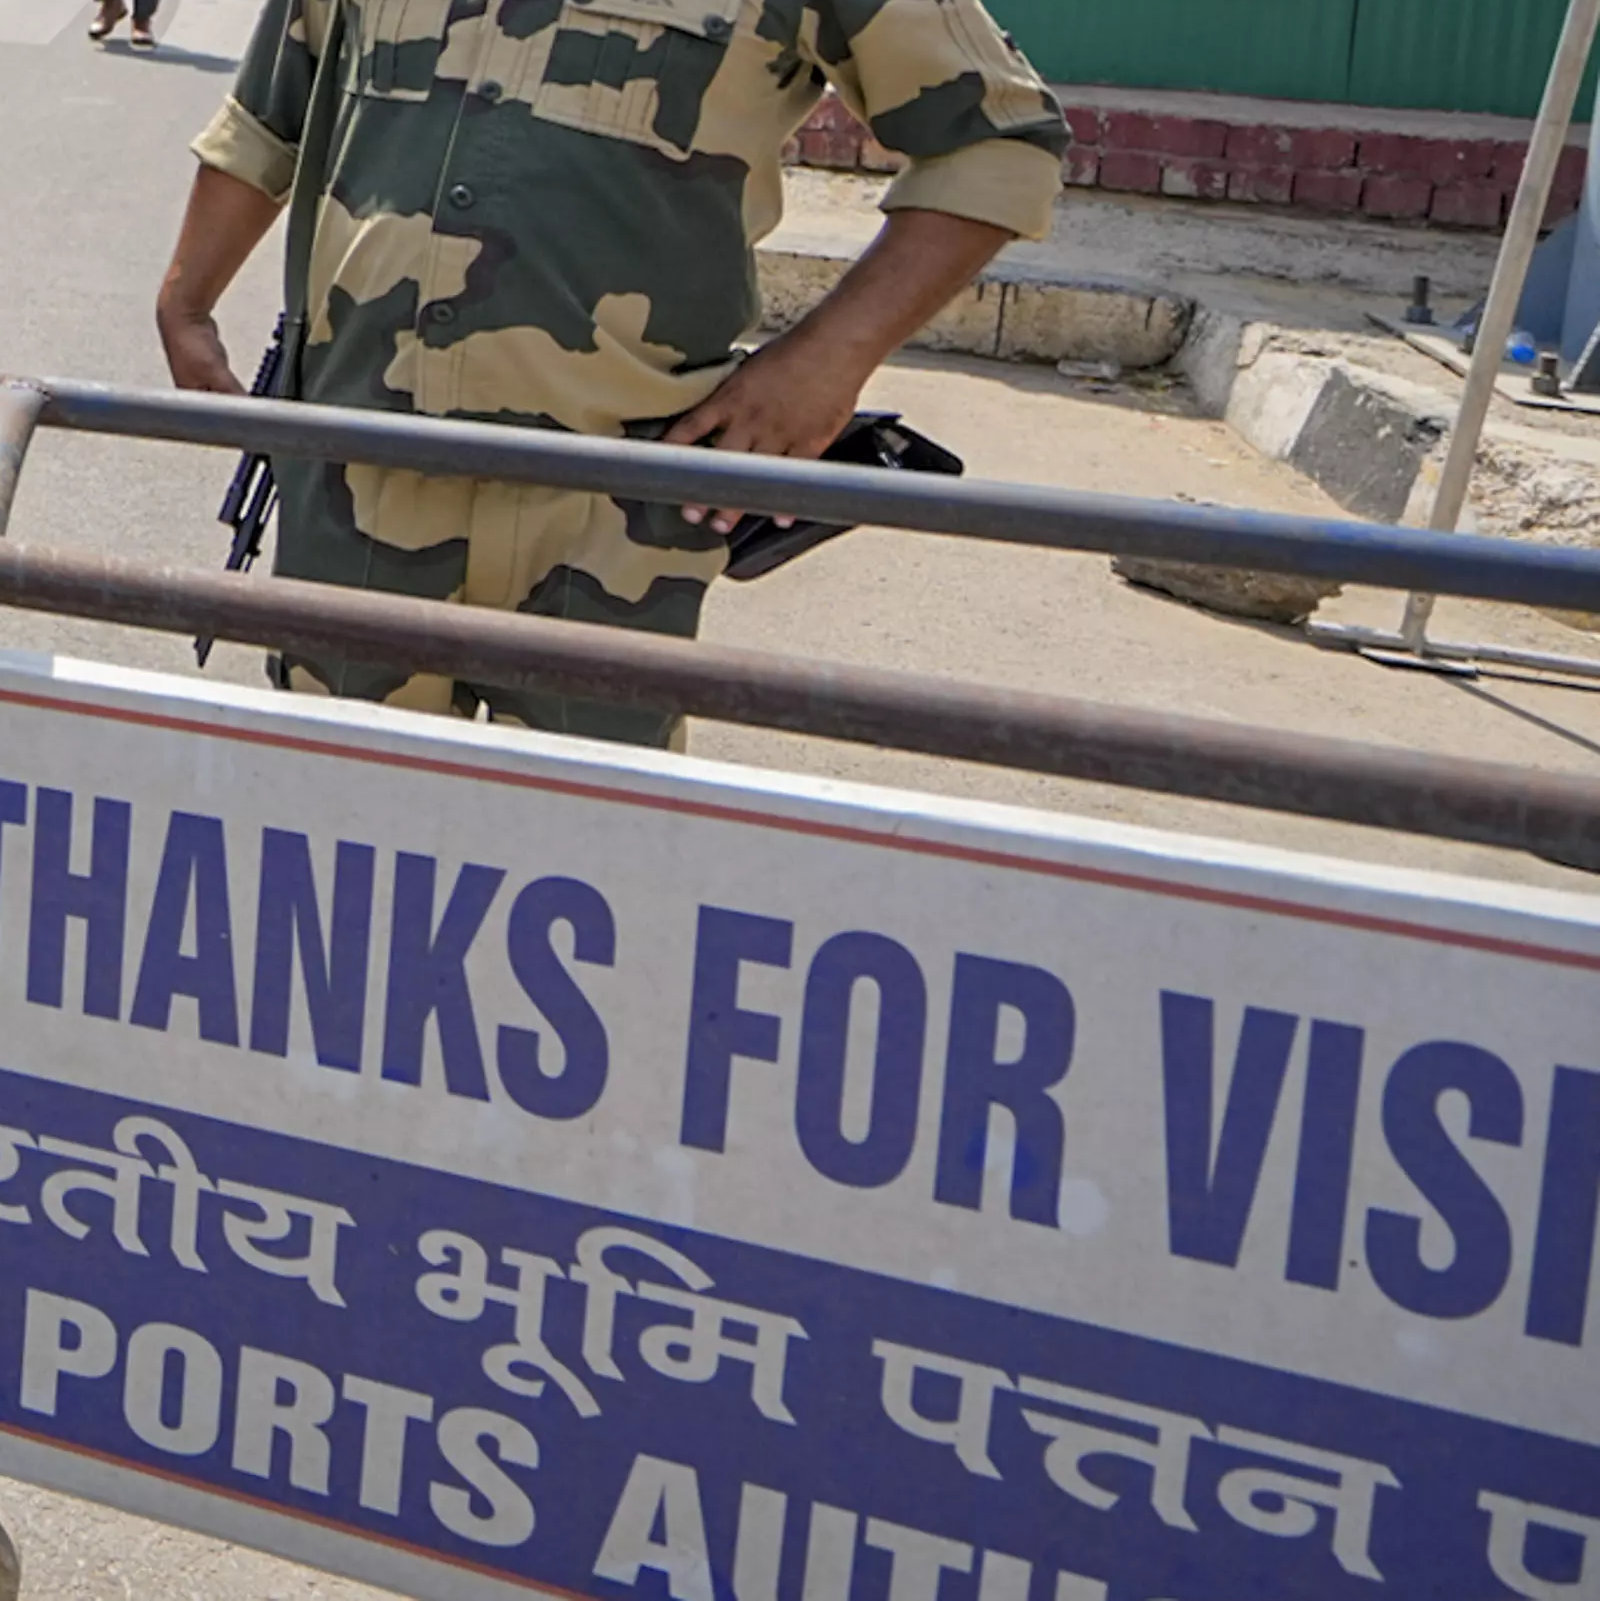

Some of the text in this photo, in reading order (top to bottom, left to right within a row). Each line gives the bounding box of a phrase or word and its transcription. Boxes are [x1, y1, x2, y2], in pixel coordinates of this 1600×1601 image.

[679, 903, 1076, 1230] FOR
[19, 1287, 541, 1549] PORTS
[414, 1224, 810, 1427] भूमि
[871, 1337, 1403, 1583] पत्तन
